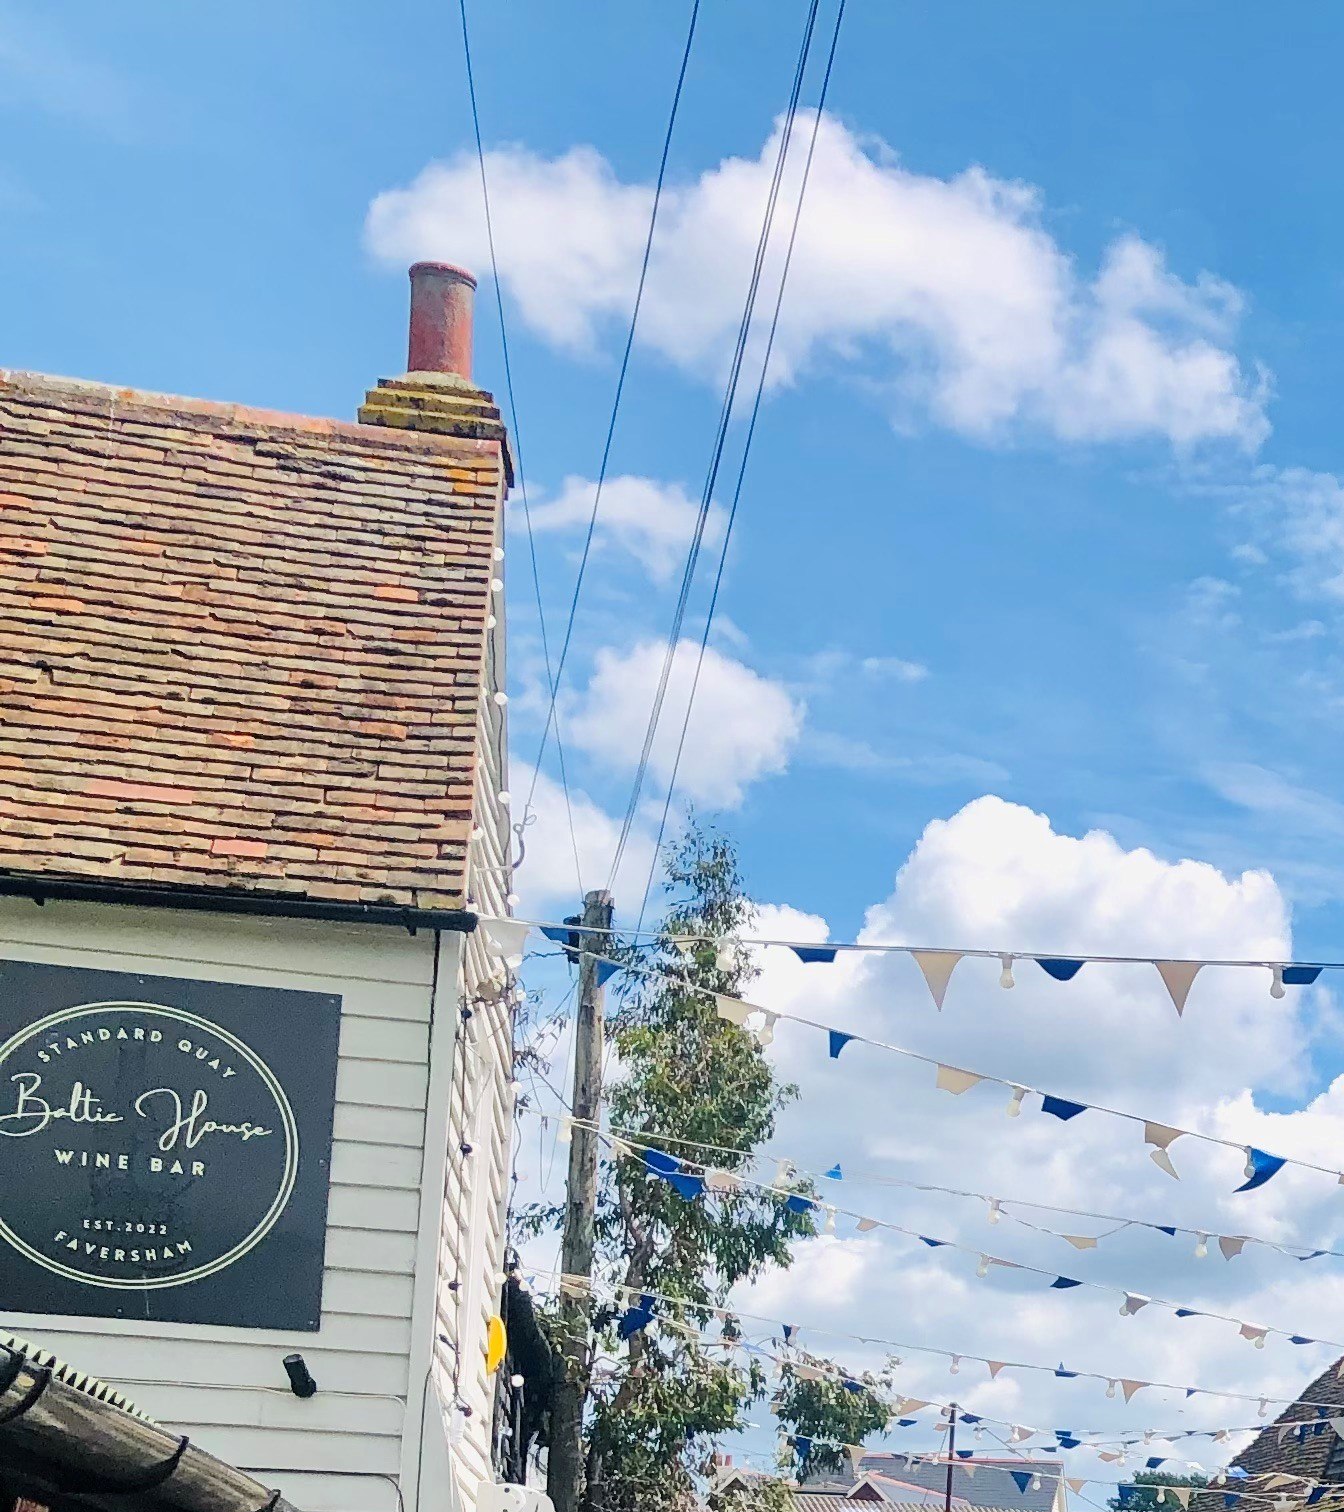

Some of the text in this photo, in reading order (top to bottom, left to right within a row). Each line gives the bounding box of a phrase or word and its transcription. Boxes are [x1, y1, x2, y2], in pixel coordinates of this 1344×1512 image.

[37, 1026, 237, 1080] STANDARD QUAY
[0, 1072, 273, 1152] Baltic House
[54, 1149, 206, 1177] WINE BAR
[53, 1230, 194, 1262] FAVERSHAM
